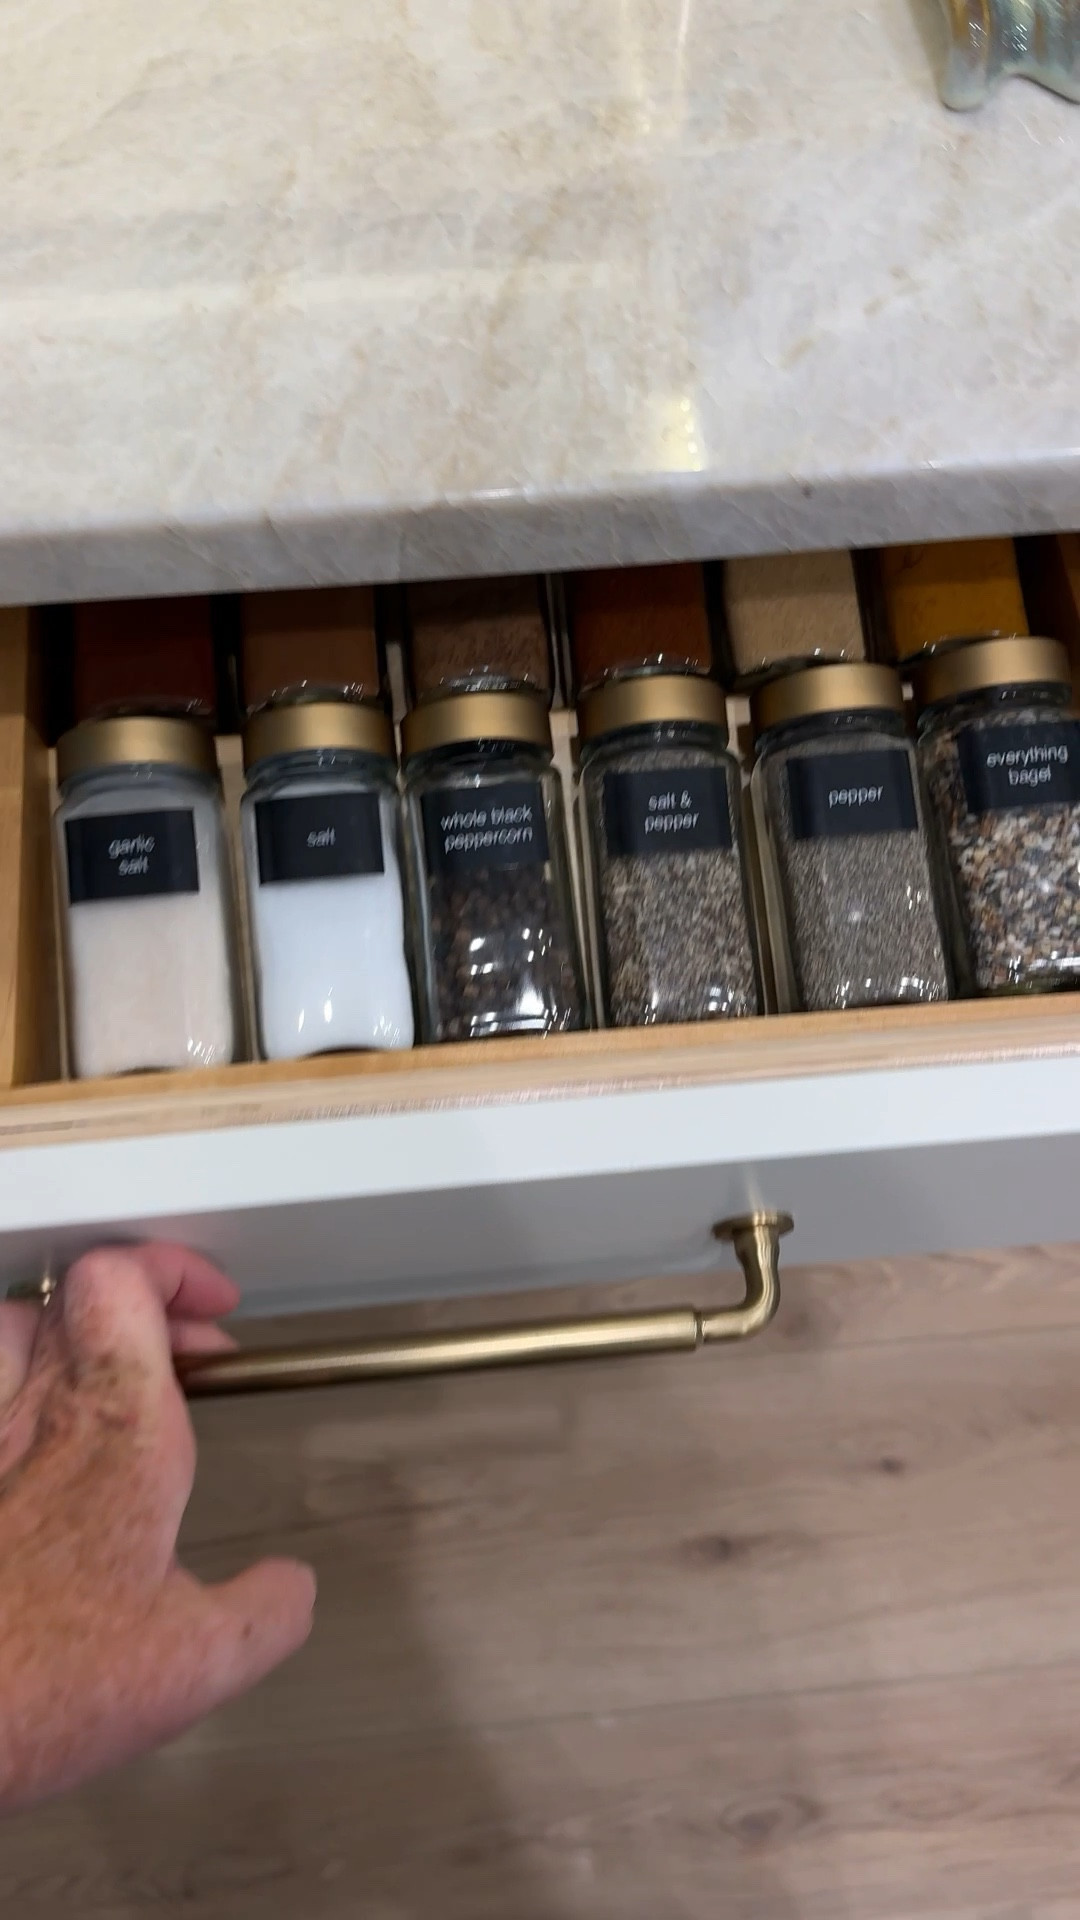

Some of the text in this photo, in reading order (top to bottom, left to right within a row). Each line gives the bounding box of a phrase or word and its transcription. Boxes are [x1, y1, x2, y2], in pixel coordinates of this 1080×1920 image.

[987, 744, 1068, 768] everything
[1008, 763, 1051, 787] bagel
[648, 790, 692, 811] salt &
[828, 785, 884, 809] pepper
[441, 804, 533, 831] whole black
[645, 812, 699, 835] pepper
[108, 834, 155, 859] garlic
[307, 826, 336, 848] salt
[445, 826, 533, 855] peppercorn
[118, 856, 149, 876] salt
